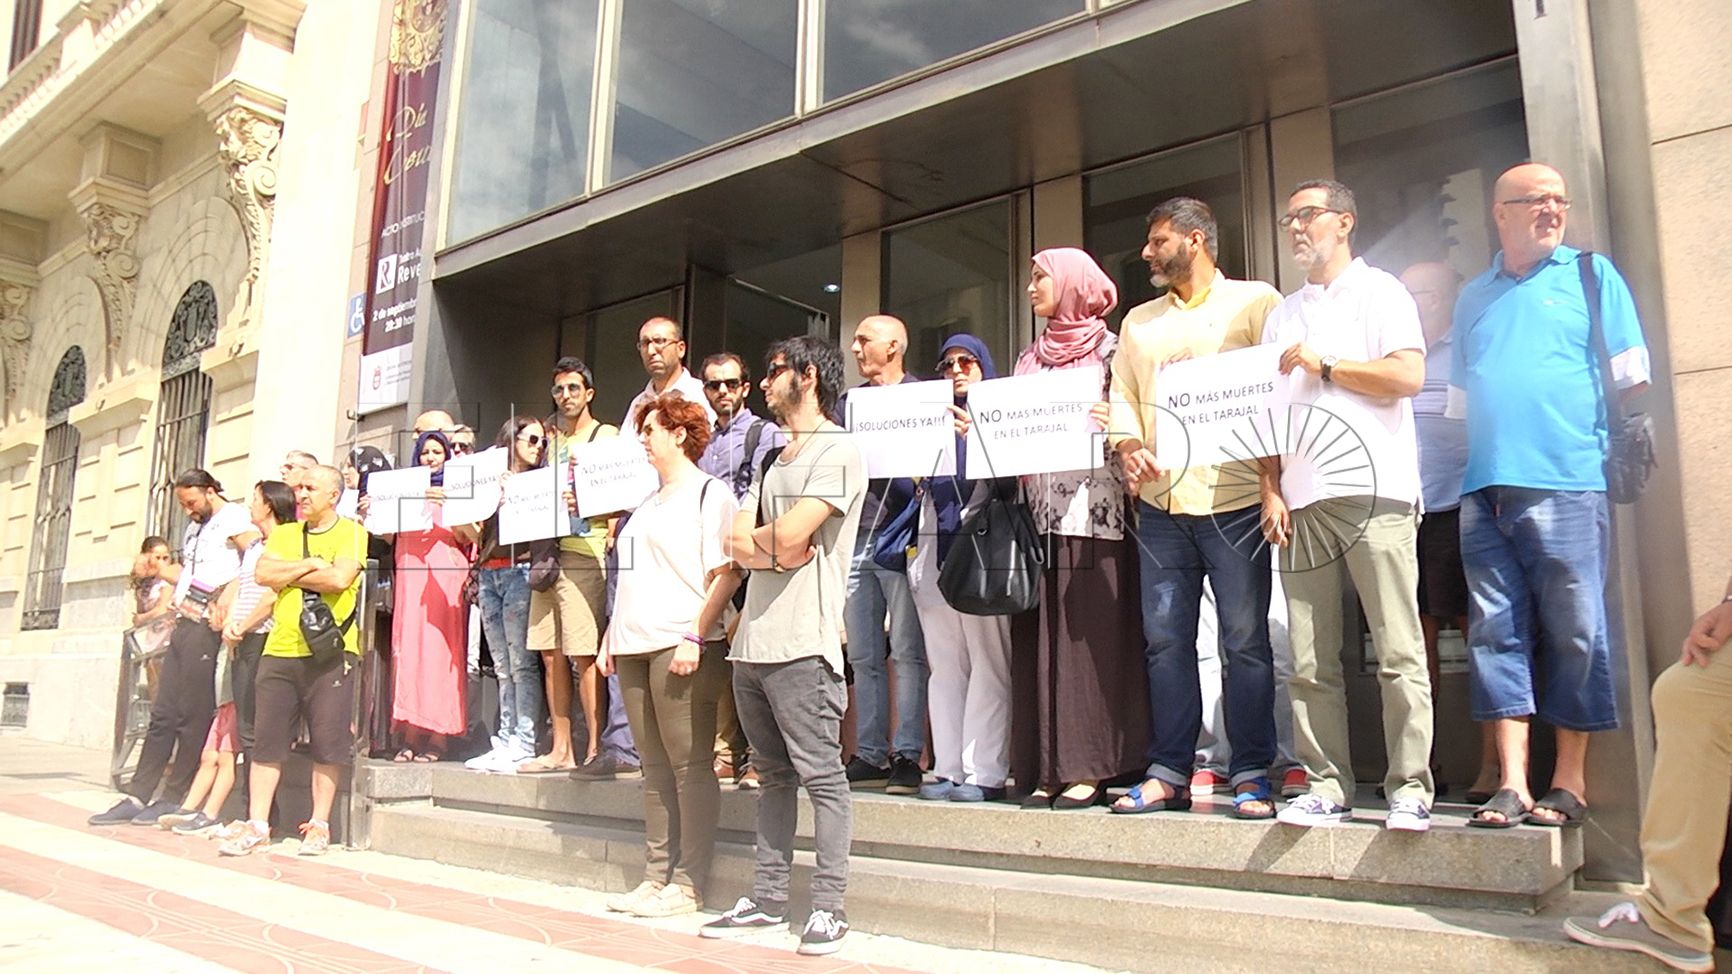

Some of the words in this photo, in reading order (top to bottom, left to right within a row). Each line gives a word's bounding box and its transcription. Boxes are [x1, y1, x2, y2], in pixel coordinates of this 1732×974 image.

[398, 263, 421, 285] Reve
[387, 298, 416, 317] septiembr
[1168, 393, 1190, 408] NO
[1222, 381, 1273, 399] MUERTES
[980, 409, 1002, 423] NO
[1032, 403, 1082, 417] MUERTES
[1183, 415, 1195, 426] EN
[1199, 413, 1210, 423] EL
[1213, 405, 1258, 421] TARAJAL
[994, 430, 1006, 440] EN
[1010, 429, 1020, 437] EL
[1024, 423, 1067, 436] TARAJAL
